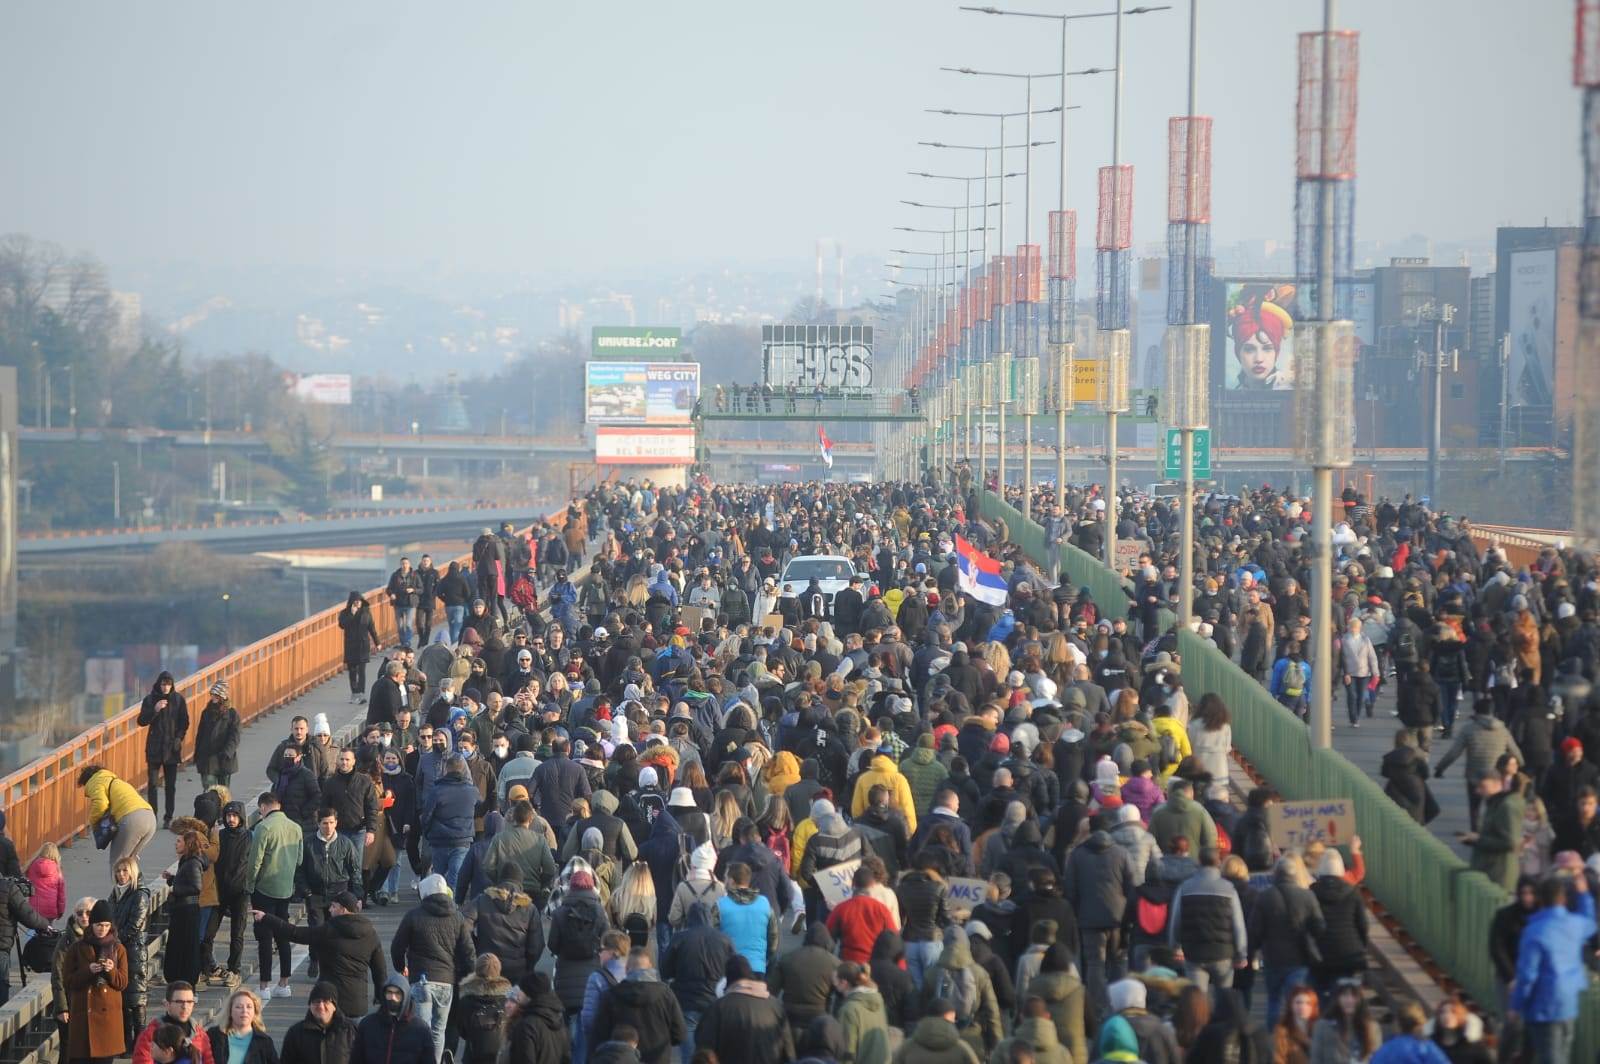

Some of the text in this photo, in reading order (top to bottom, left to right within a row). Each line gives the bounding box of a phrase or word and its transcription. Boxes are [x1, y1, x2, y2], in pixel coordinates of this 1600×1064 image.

[598, 336, 678, 347] UNIVEREXPORT
[647, 371, 697, 380] WEG CITY
[950, 884, 983, 902] NAS
